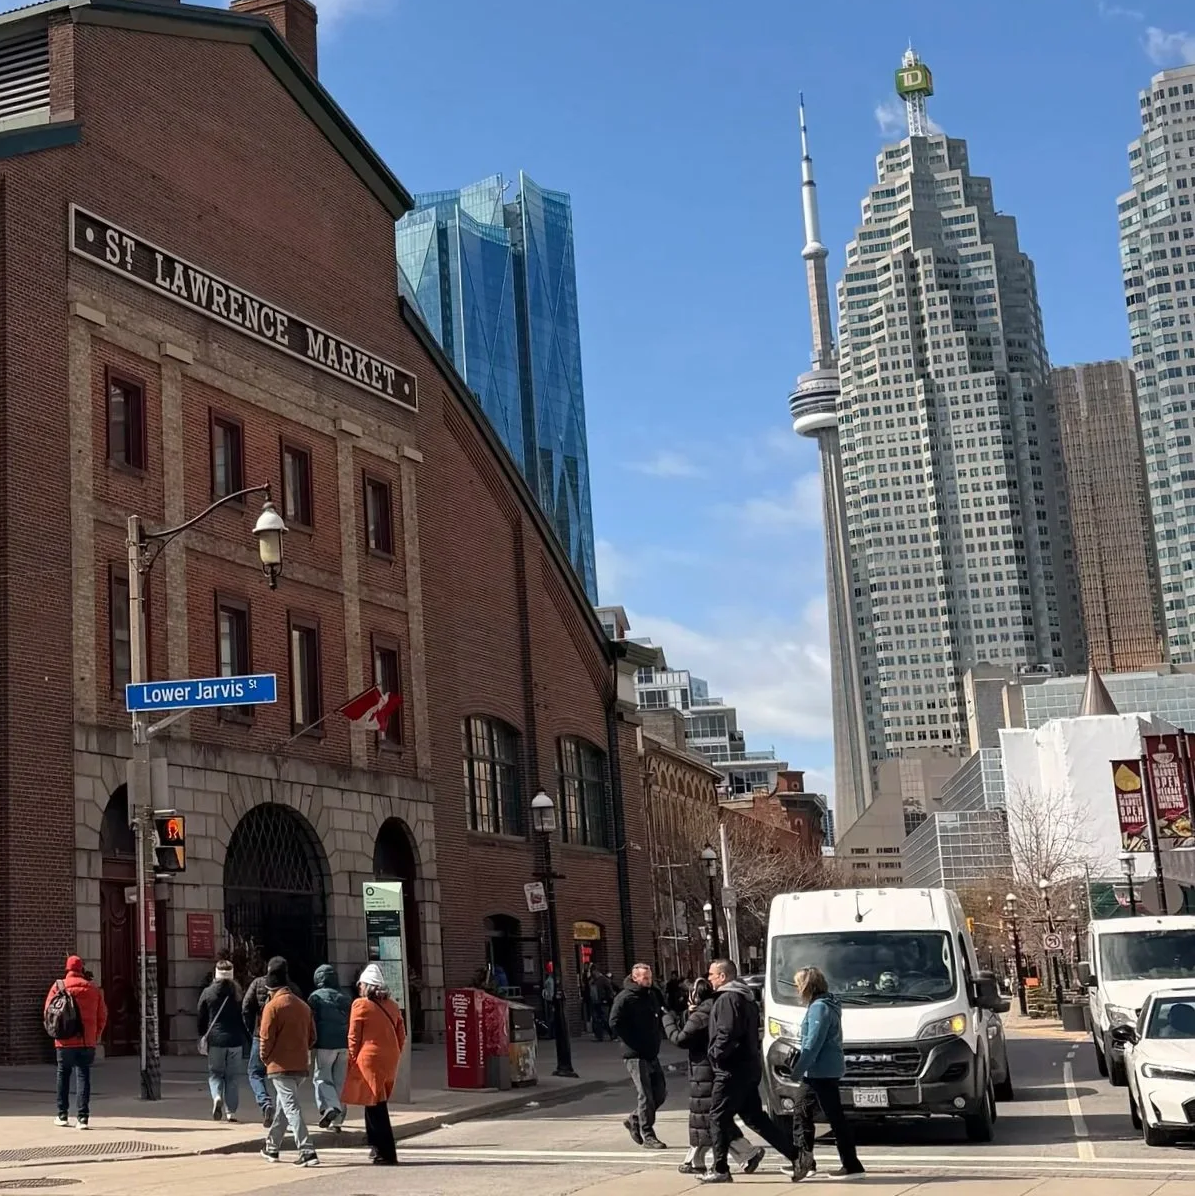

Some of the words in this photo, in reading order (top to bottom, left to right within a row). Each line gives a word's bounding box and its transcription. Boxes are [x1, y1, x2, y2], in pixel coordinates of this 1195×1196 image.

[898, 70, 922, 86] TD
[155, 252, 289, 345] LAWRENCE
[306, 327, 395, 396] MARKET
[143, 686, 191, 703] Lower
[195, 680, 243, 700] Jarvis
[248, 679, 257, 689] St
[455, 1019, 467, 1065] FREE
